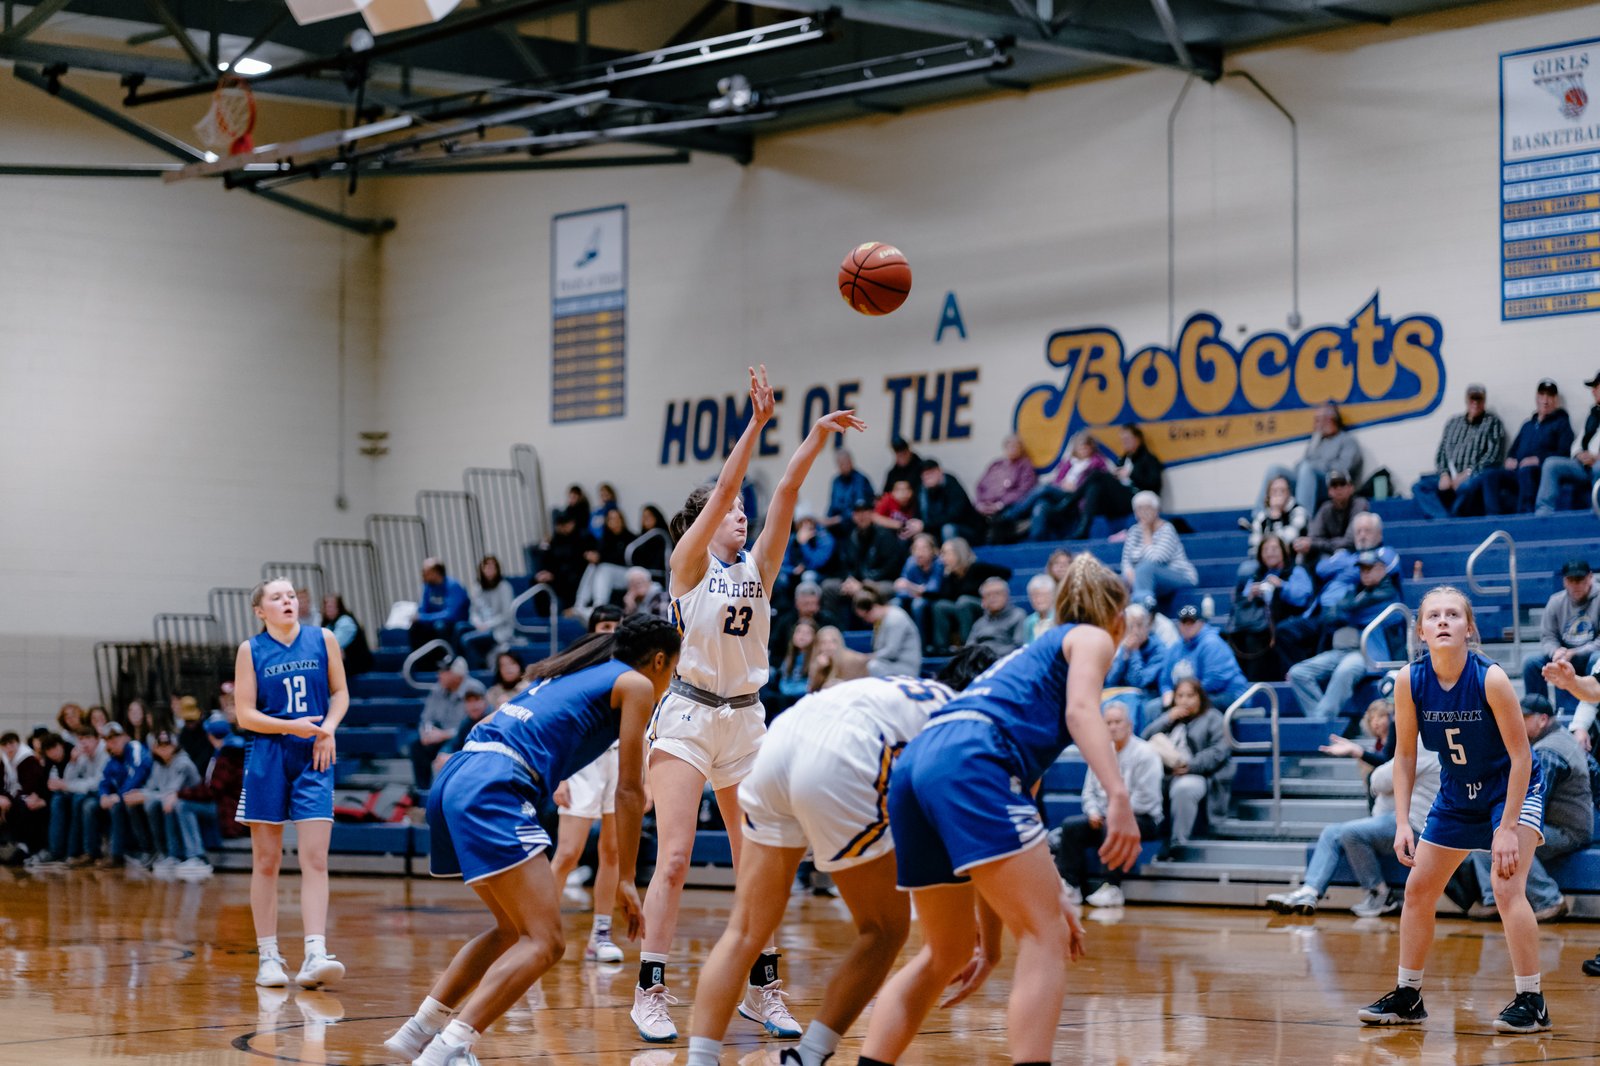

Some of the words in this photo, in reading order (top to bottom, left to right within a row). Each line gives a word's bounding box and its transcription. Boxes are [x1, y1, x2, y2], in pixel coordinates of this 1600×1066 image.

[1532, 52, 1589, 75] GIRLS
[932, 290, 969, 344] A
[1014, 290, 1446, 473] Bobcats
[884, 365, 980, 442] THE
[723, 605, 753, 636] 23
[264, 660, 319, 677] NEWARK
[283, 675, 308, 713] 12
[1444, 727, 1467, 765] 5
